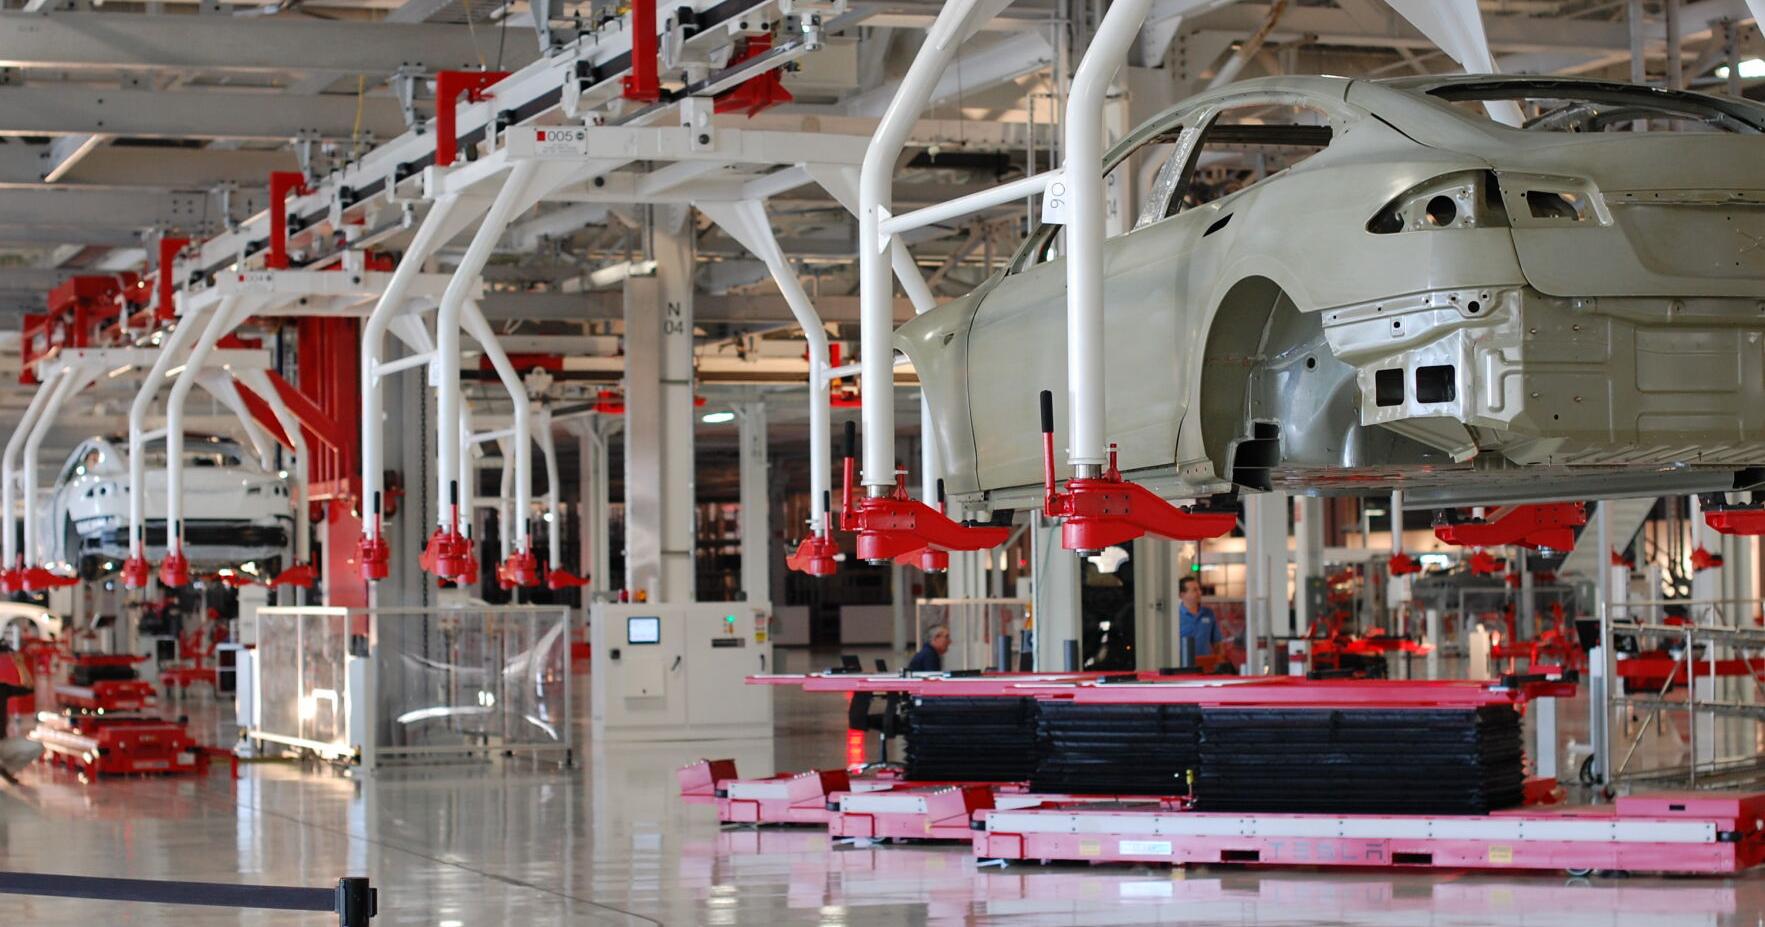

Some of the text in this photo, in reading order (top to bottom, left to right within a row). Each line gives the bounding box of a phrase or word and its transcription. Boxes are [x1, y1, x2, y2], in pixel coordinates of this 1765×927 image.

[548, 131, 573, 141] 005
[668, 302, 680, 316] N
[664, 320, 682, 335] 04
[1269, 842, 1383, 860] TESLA
